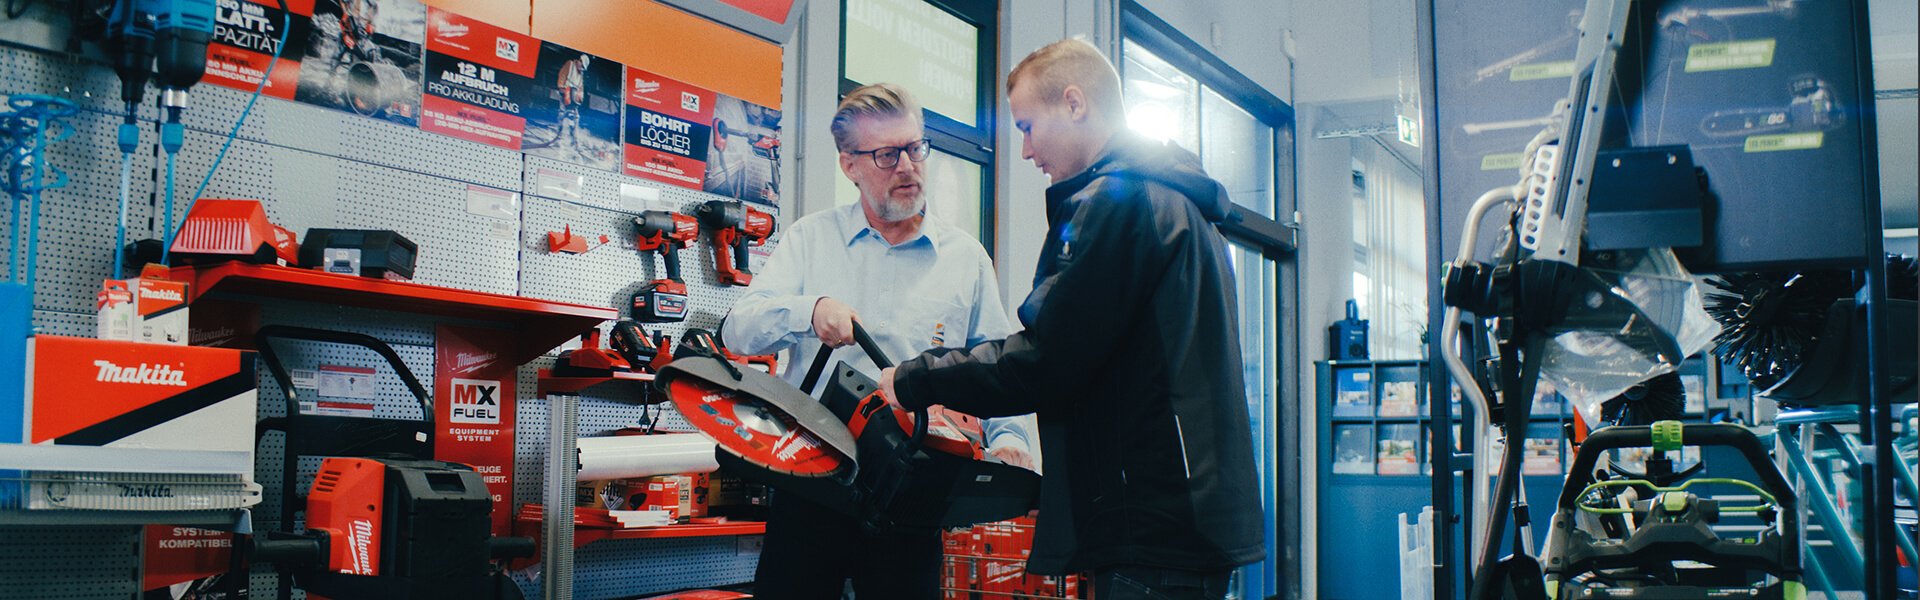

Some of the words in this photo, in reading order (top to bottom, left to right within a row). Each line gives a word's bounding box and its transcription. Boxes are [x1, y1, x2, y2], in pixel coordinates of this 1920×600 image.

[498, 41, 516, 53] MX
[457, 61, 477, 78] 12
[480, 67, 496, 82] M
[441, 70, 509, 96] AUFBRUCH
[428, 81, 451, 97] PRO
[452, 89, 520, 114] AKKULADUNG
[683, 93, 698, 106] MX
[640, 110, 692, 135] BOHRT
[640, 125, 691, 150] LÖCHER
[456, 352, 497, 368] Milwaukee
[94, 360, 187, 386] Makita
[454, 383, 497, 406] MX
[453, 408, 497, 419] FUEL
[449, 428, 500, 436] EQUIPMENT
[159, 539, 232, 549] KOMPATIBEL
